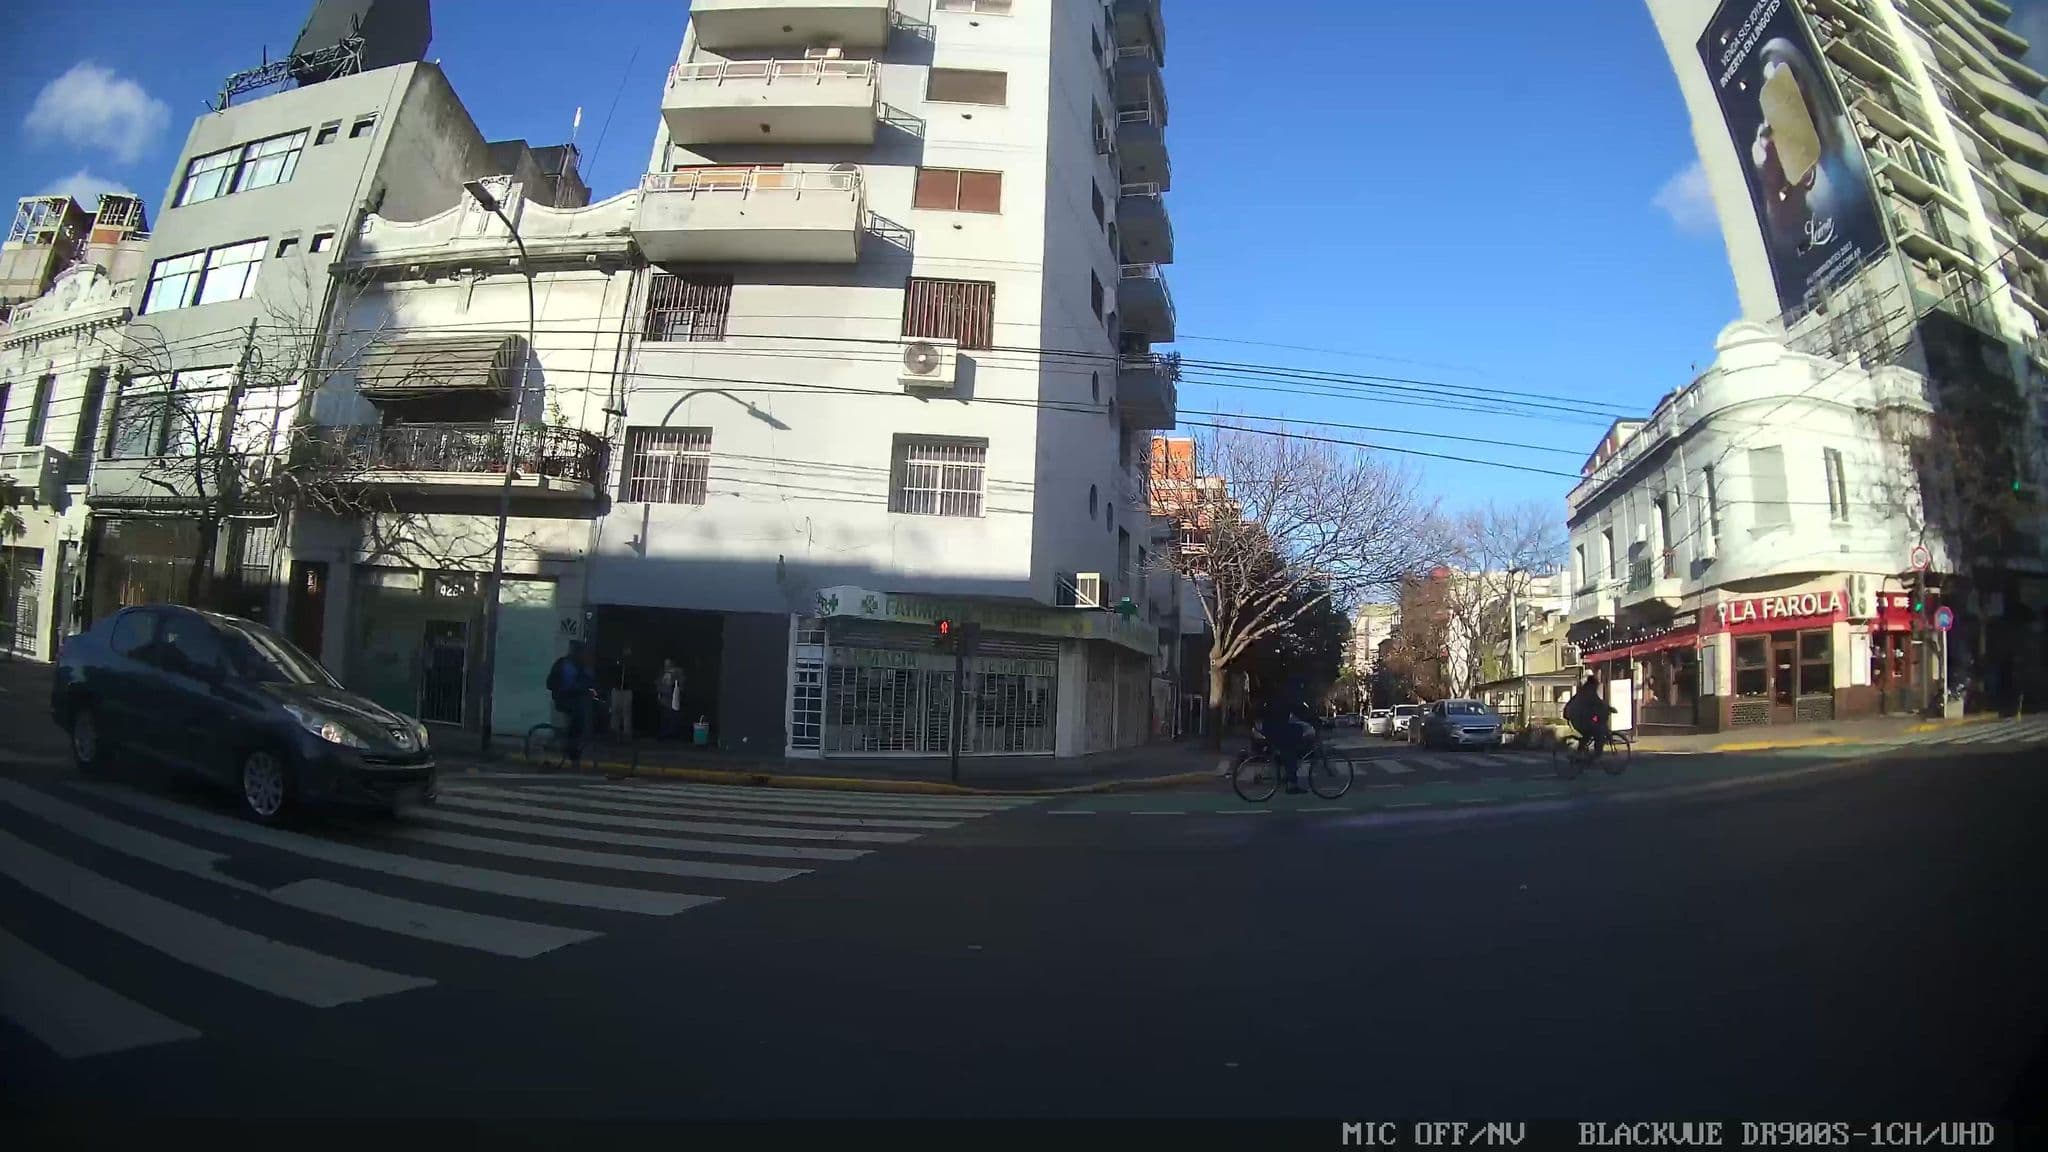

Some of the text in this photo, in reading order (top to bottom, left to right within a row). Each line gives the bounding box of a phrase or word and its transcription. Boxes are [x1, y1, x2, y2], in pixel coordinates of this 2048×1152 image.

[1738, 20, 1752, 42] SUS
[1743, 34, 1755, 54] EN
[1751, 0, 1781, 43] LINGOTES
[1729, 600, 1757, 623] LA
[1761, 590, 1843, 619] FAROLA
